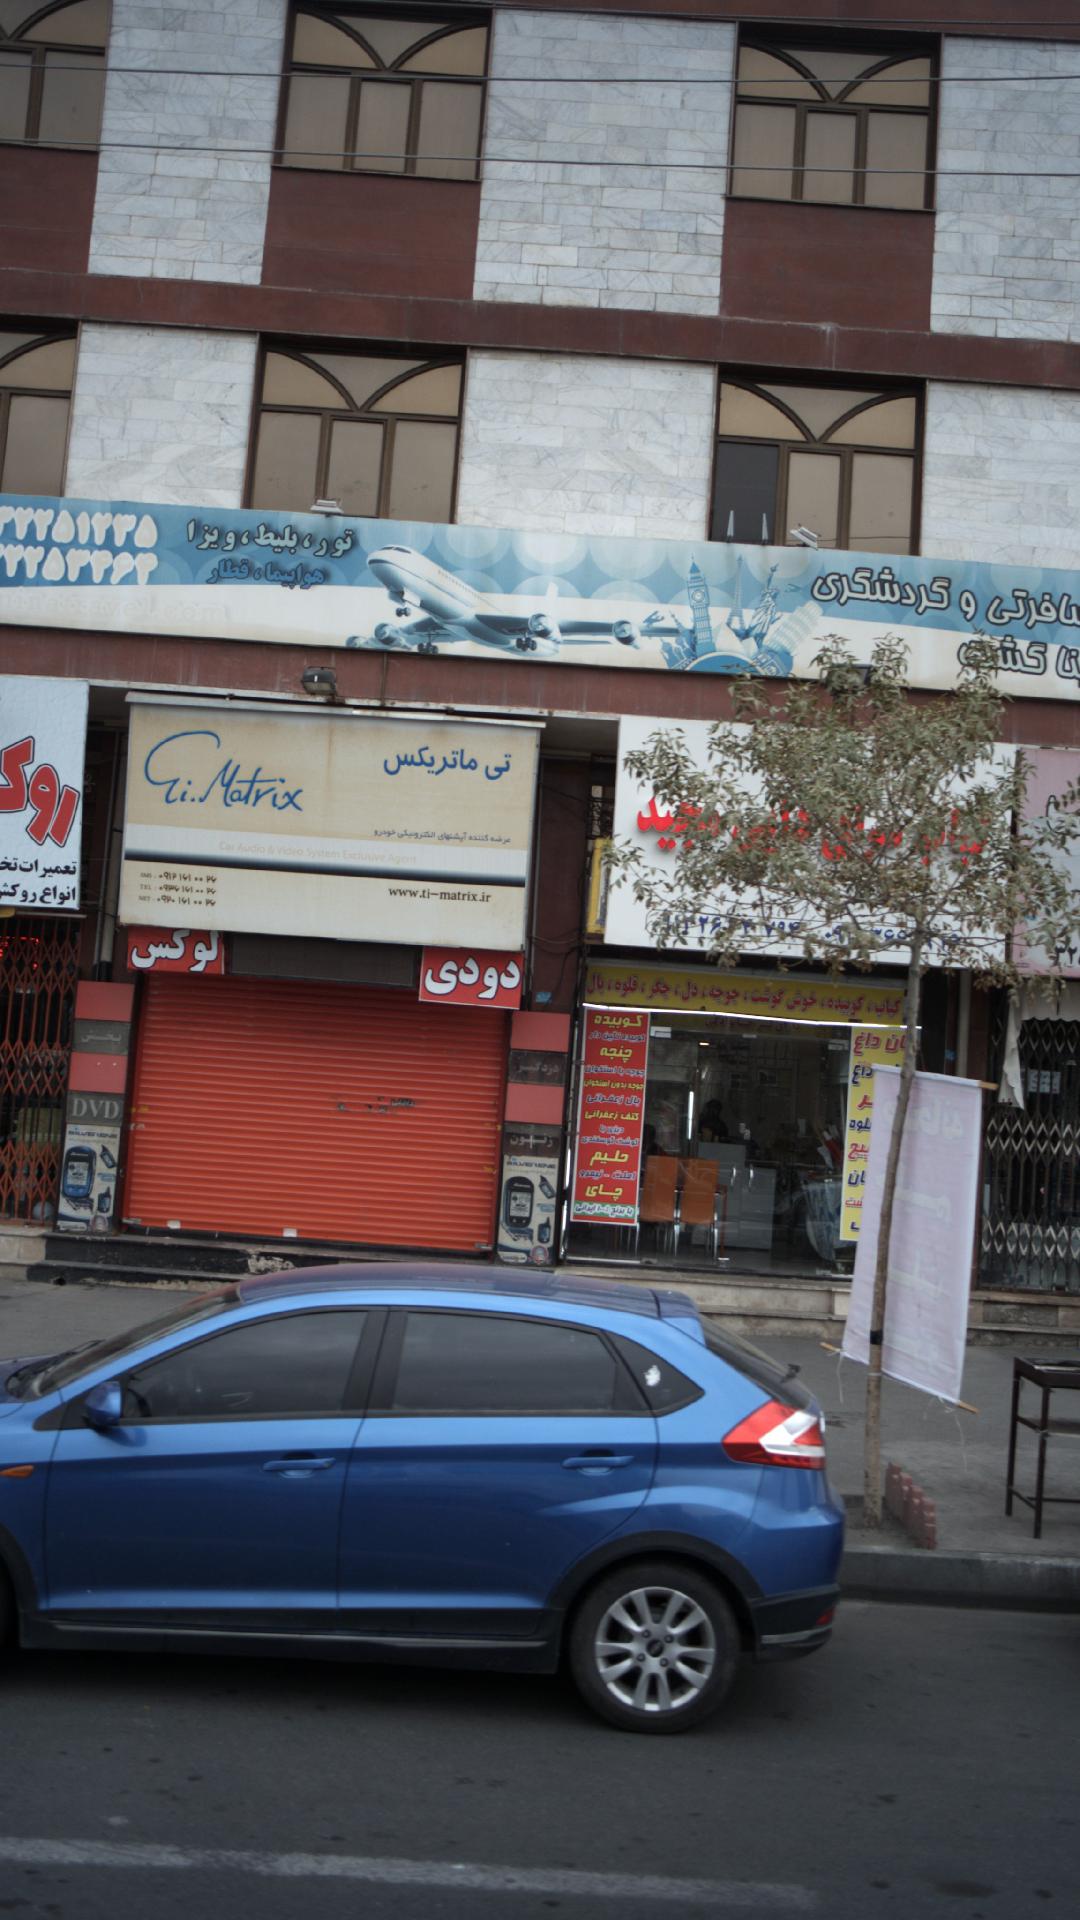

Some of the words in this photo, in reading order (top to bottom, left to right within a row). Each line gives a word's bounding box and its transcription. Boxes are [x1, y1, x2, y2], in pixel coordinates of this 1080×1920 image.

[186, 518, 237, 551] ویزا
[0, 543, 159, 585] ۲۲۵۳۴۶۴
[206, 558, 251, 584] قطار
[811, 566, 951, 615] گردشگری
[959, 589, 977, 622] و
[383, 745, 479, 776] ماتریکس
[483, 752, 512, 781] تی
[374, 828, 396, 838] خودرو
[19, 858, 78, 878] تعمیرات
[39, 884, 77, 906] انواع
[388, 886, 492, 904] www.ti-matrix.ir
[130, 928, 222, 973] لوکس
[423, 955, 521, 1000] دودی
[593, 1014, 644, 1029] کوبیده
[600, 1045, 633, 1063] چنجه
[853, 1031, 881, 1057] داغ
[71, 1099, 120, 1119] DVD
[584, 1110, 618, 1121] زعفرانی
[590, 1149, 629, 1167] حلیم
[585, 1184, 623, 1202] چای
